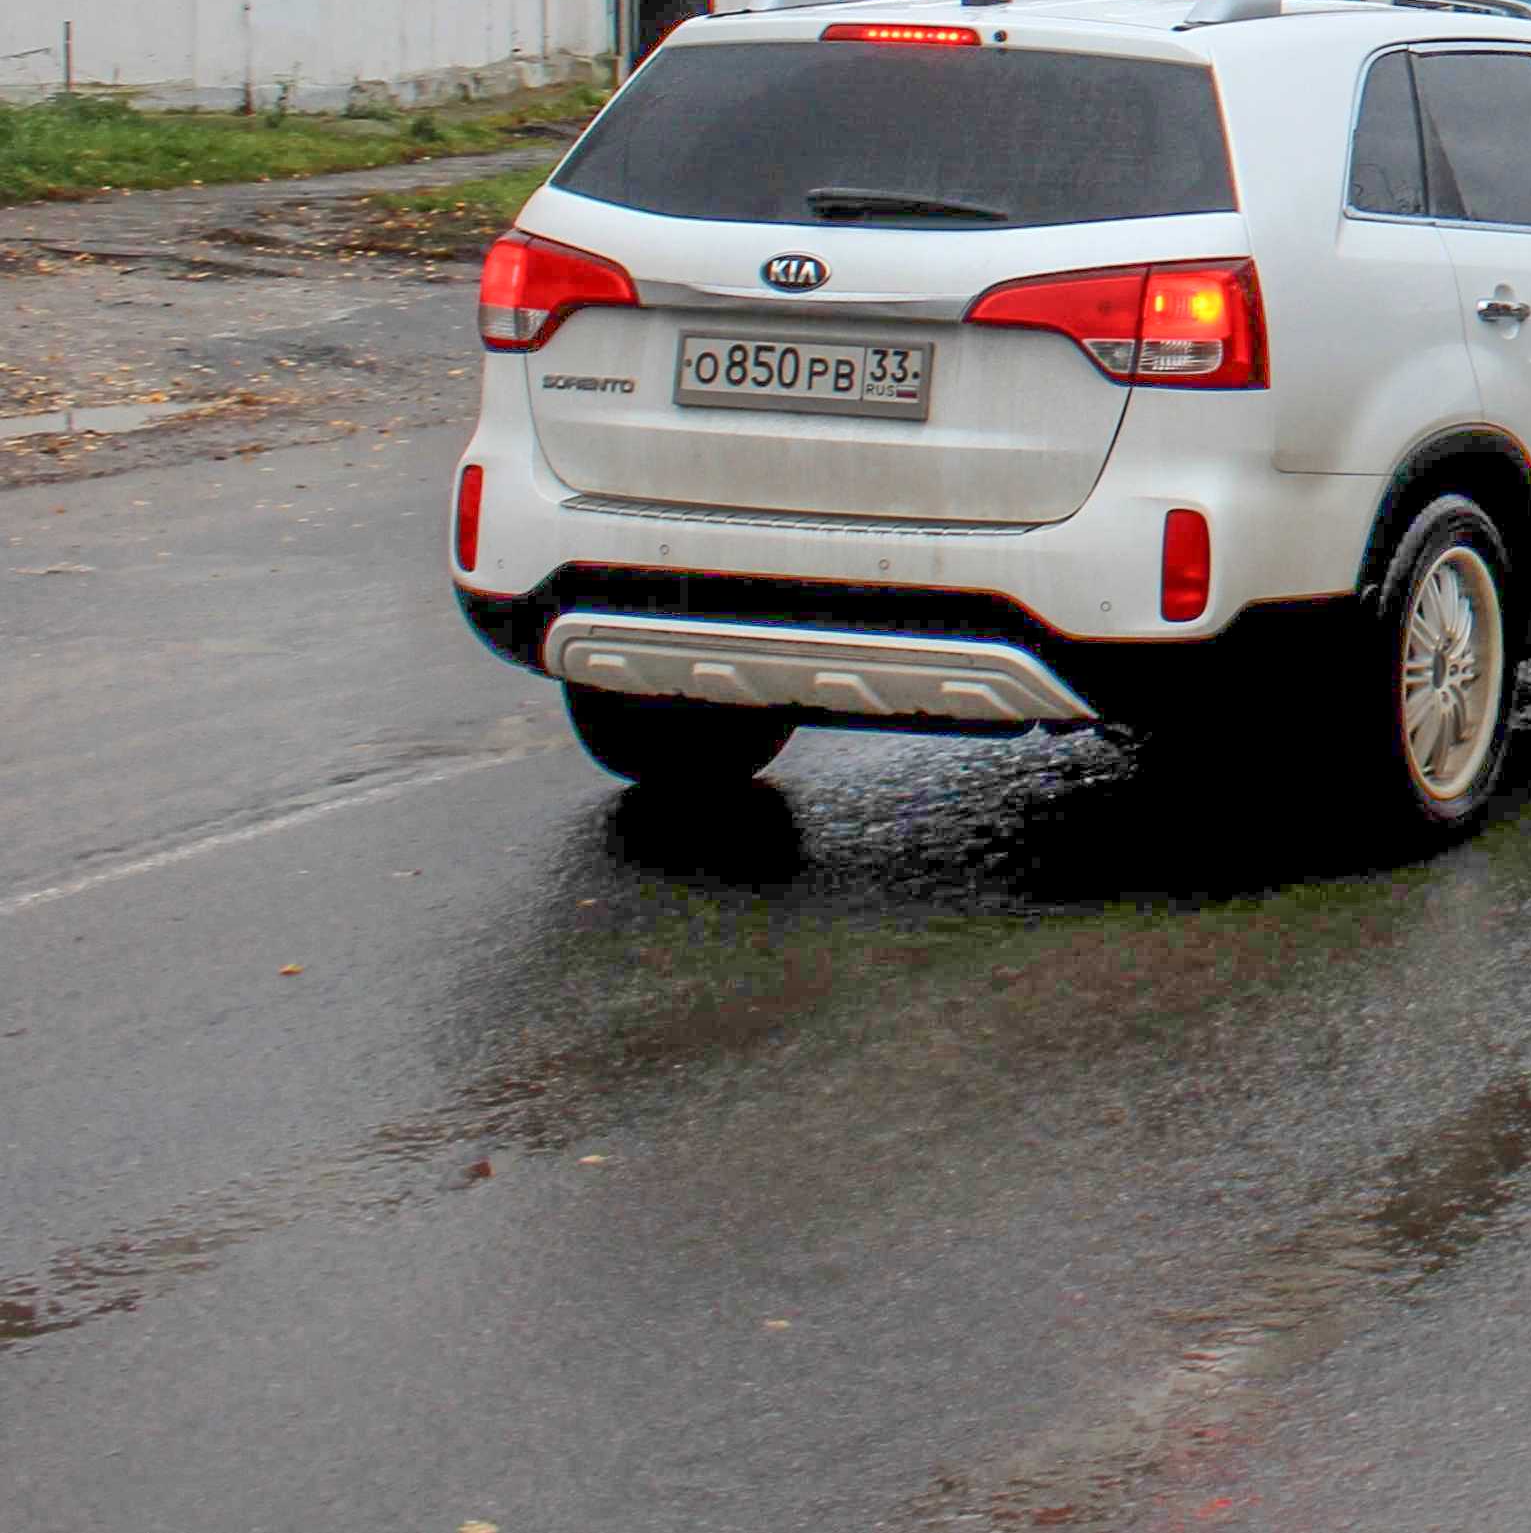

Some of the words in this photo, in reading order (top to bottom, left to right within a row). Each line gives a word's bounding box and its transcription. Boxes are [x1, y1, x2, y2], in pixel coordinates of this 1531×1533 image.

[769, 259, 818, 284] KIA
[869, 349, 909, 382] 33
[865, 383, 896, 397] RUS
